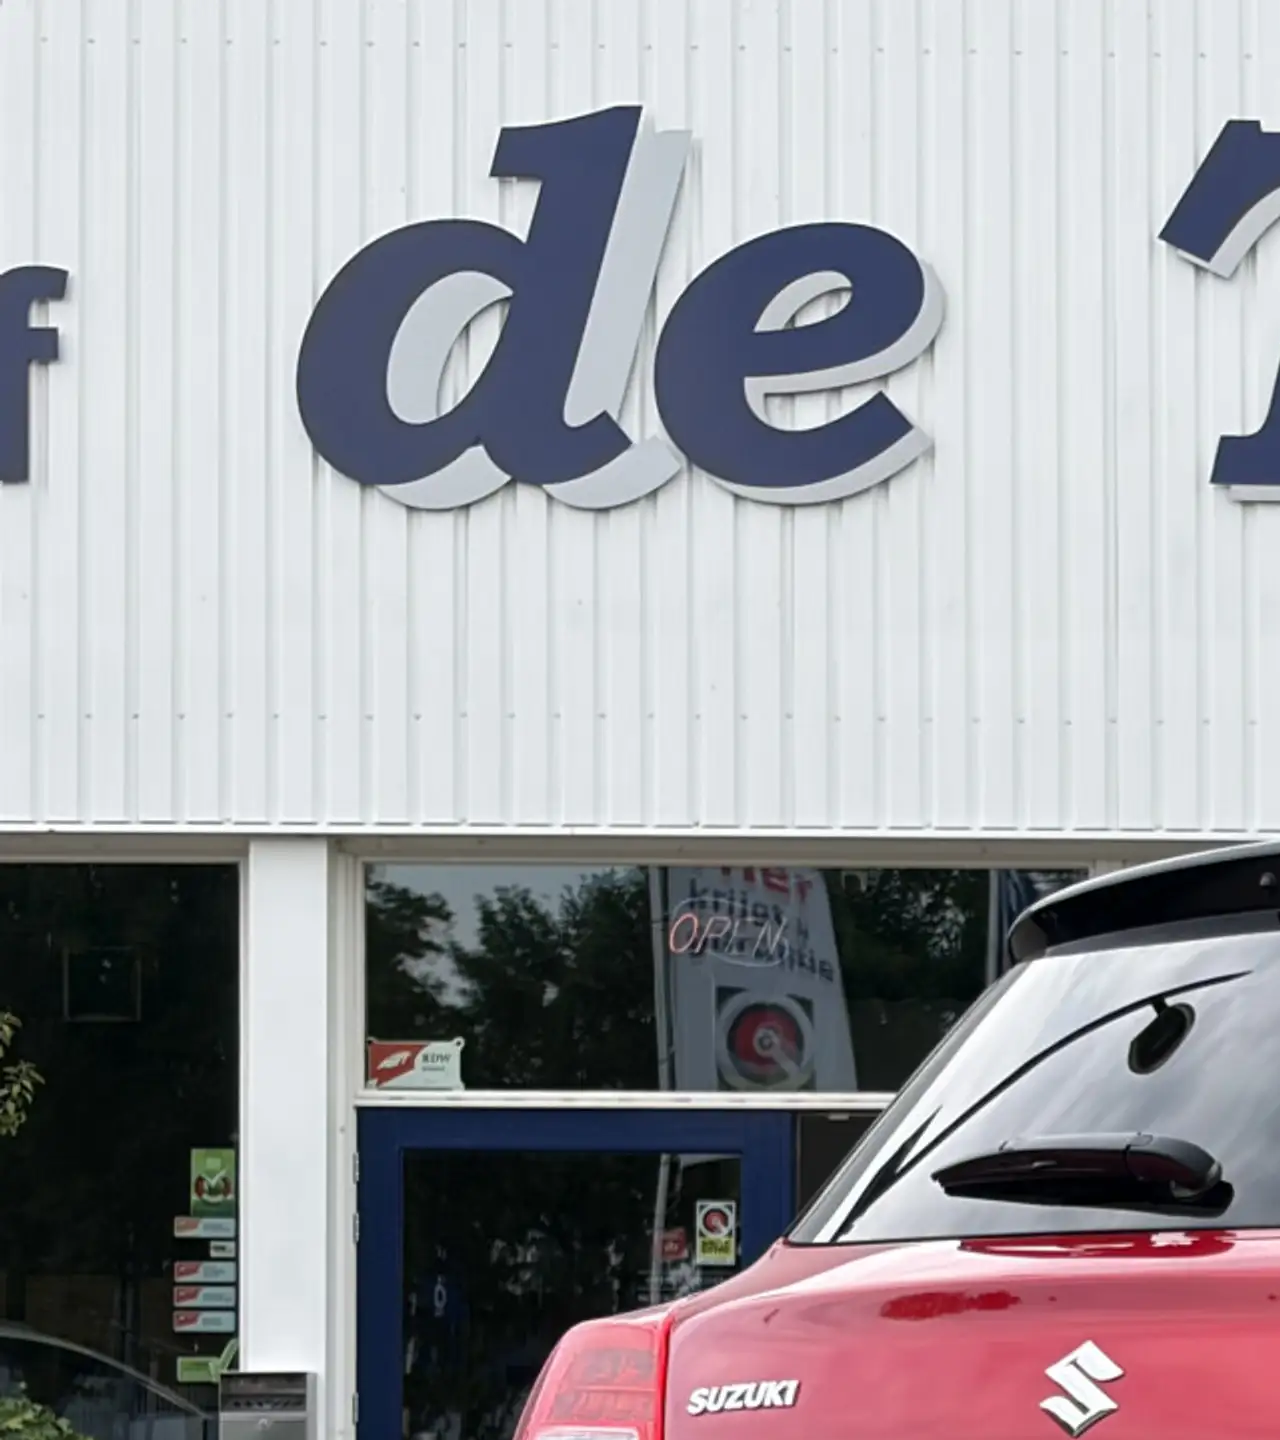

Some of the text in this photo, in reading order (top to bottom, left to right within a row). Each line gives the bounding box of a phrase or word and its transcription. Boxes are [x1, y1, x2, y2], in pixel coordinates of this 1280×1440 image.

[296, 104, 937, 503] de
[669, 915, 788, 960] OPEN
[687, 1380, 801, 1416] SUZUKI
